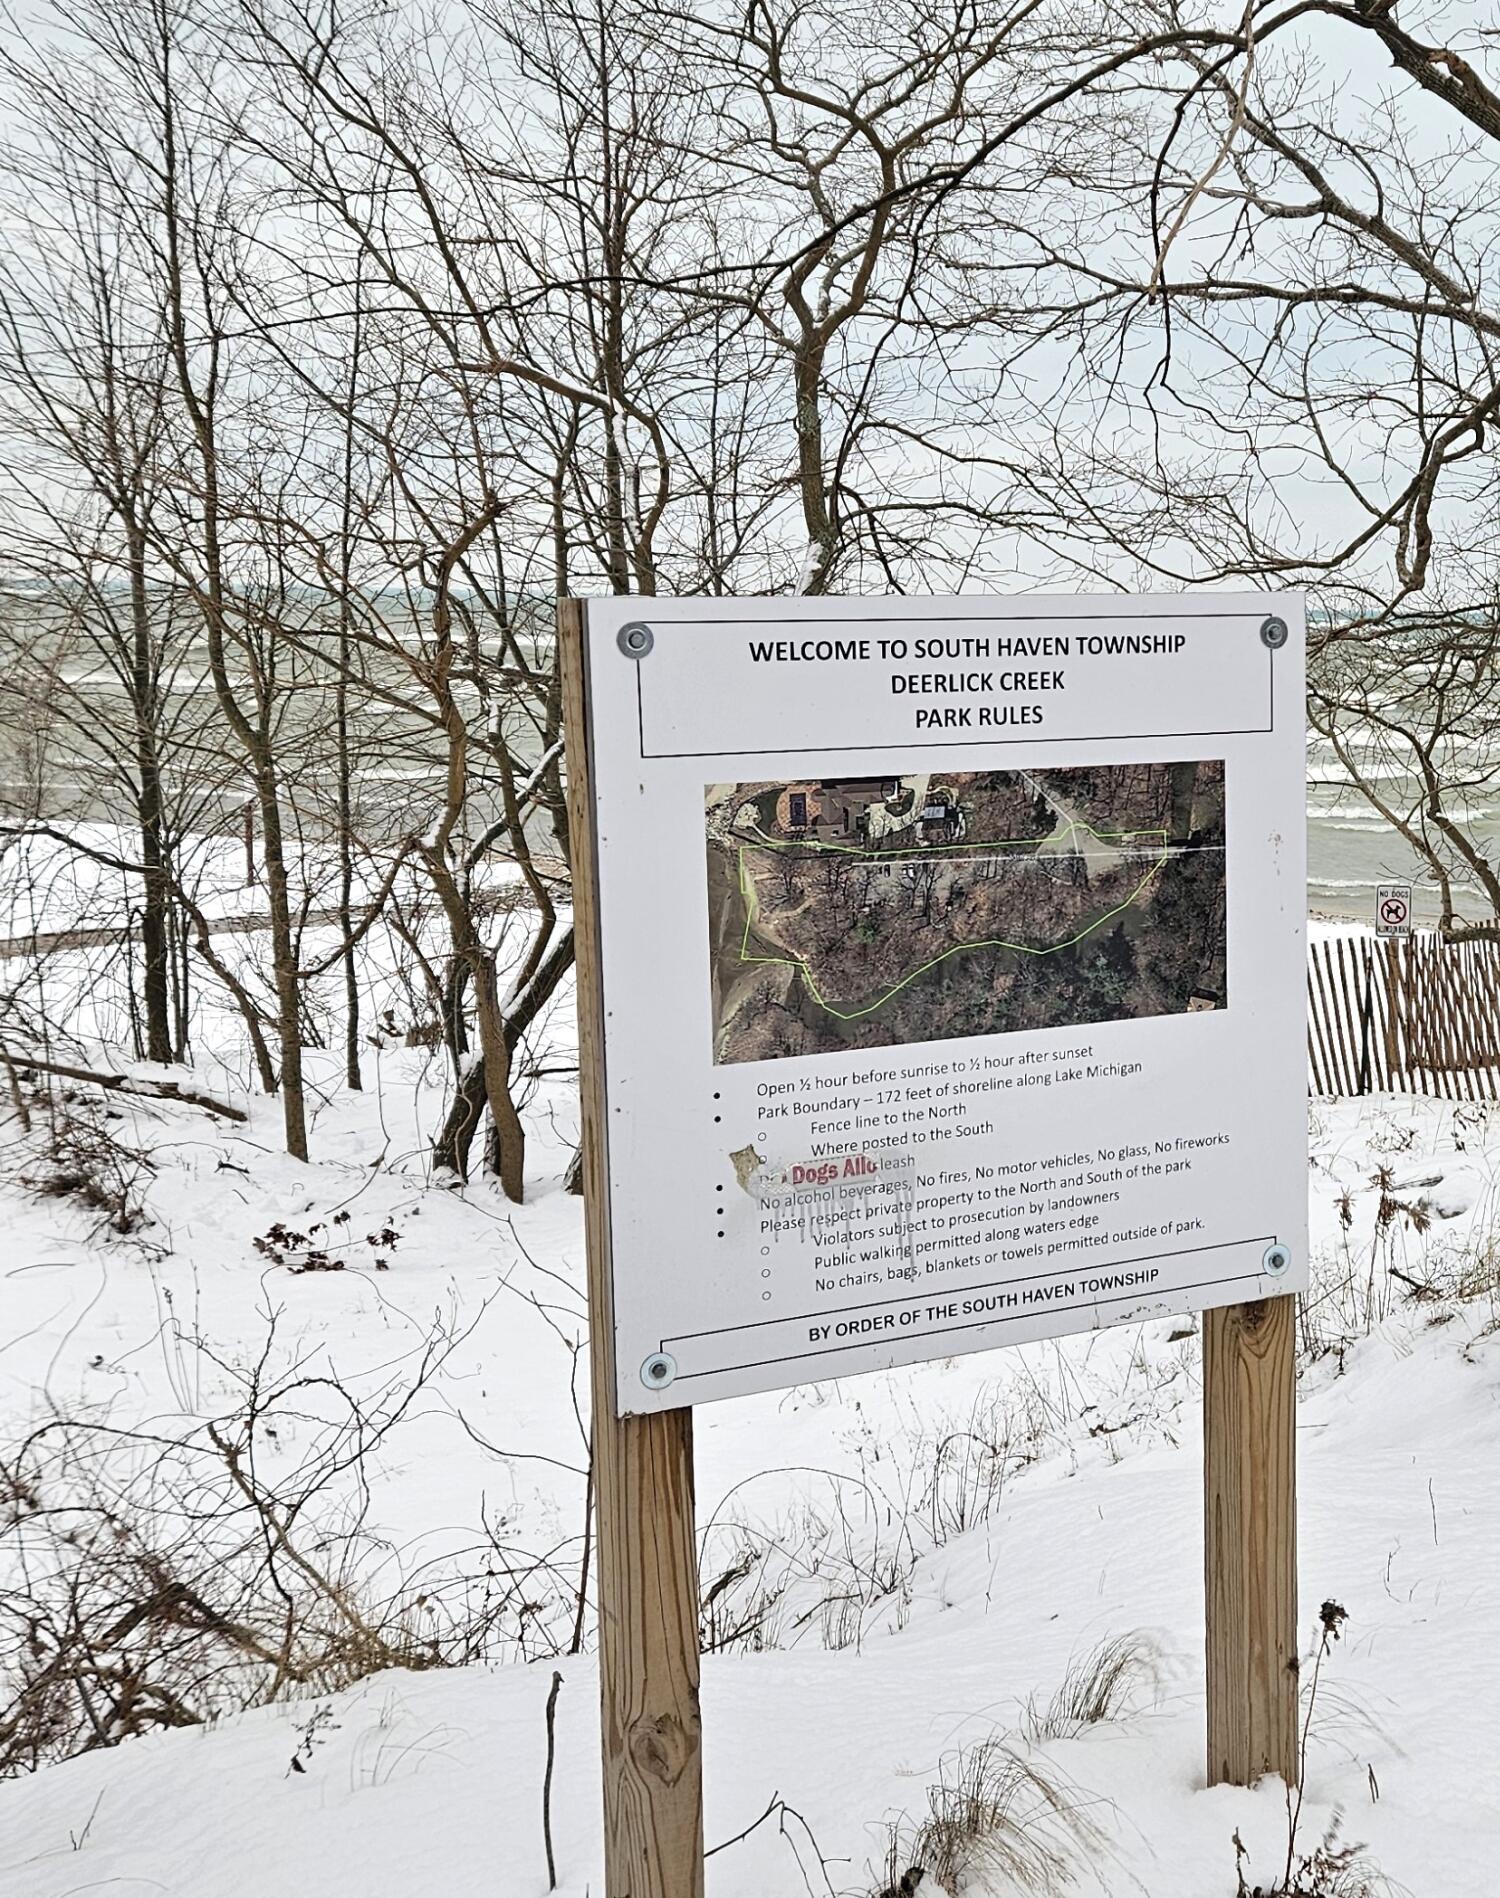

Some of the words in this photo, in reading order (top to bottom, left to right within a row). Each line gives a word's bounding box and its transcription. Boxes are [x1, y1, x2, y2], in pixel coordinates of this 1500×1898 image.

[749, 640, 870, 661] WELCOME
[877, 640, 907, 659] TO
[914, 638, 990, 658] SOUTH
[998, 637, 1069, 656] HAVEN
[1076, 635, 1185, 655] TOWNSHIP
[892, 673, 994, 694] DEERLICK
[1000, 671, 1064, 690] CREEK
[916, 708, 971, 728] PARK
[980, 706, 1043, 725] RULES
[757, 1081, 794, 1097] Open
[800, 1078, 811, 1090] ½
[815, 1074, 847, 1089] hour
[853, 1068, 896, 1085] before
[900, 1063, 948, 1079] sunrise
[952, 1060, 966, 1073] to
[970, 1057, 980, 1070] ½
[984, 1053, 1014, 1069] hour
[1018, 1051, 1048, 1065] after
[1052, 1046, 1093, 1060] sunset
[758, 1104, 788, 1119] Park
[793, 1096, 860, 1116] Boundary
[877, 1090, 901, 1104] 172
[906, 1087, 931, 1100] feet
[936, 1083, 950, 1097] of
[953, 1077, 1012, 1094] shoreline
[1016, 1074, 1051, 1090] along
[1055, 1069, 1082, 1082] Lake
[1087, 1061, 1142, 1078] Michigan
[811, 1121, 850, 1134] Fence
[855, 1116, 879, 1128] line
[884, 1112, 897, 1124] to
[903, 1109, 924, 1122] the
[928, 1103, 966, 1118] North
[811, 1141, 857, 1156] Where
[862, 1134, 908, 1153] posted
[912, 1130, 925, 1143] to
[930, 1128, 951, 1140] the
[956, 1122, 993, 1137] South
[760, 1198, 780, 1210] No
[784, 1189, 834, 1207] alcohol
[839, 1179, 912, 1199] beverages,
[916, 1175, 935, 1187] No
[939, 1171, 971, 1185] fires,
[975, 1167, 994, 1179] No
[998, 1161, 1037, 1175] motor
[1041, 1152, 1094, 1169] vehicles,
[1098, 1148, 1115, 1160] No
[1119, 1145, 1151, 1160] glass,
[1155, 1141, 1172, 1153] No
[1175, 1133, 1230, 1150] fireworks
[793, 1163, 838, 1185] Dogs
[880, 1156, 915, 1171] leash
[760, 1216, 805, 1232] Please
[810, 1209, 861, 1227] respect
[865, 1202, 912, 1221] private
[916, 1194, 973, 1215] property
[978, 1189, 991, 1201] to
[995, 1185, 1016, 1198] the
[1020, 1179, 1056, 1194] North
[1060, 1174, 1083, 1188] and
[1087, 1167, 1123, 1183] South
[1126, 1165, 1138, 1178] of
[1142, 1163, 1162, 1175] the
[1166, 1159, 1191, 1173] park
[814, 1229, 875, 1247] Violators
[879, 1221, 927, 1240] subject
[931, 1217, 945, 1229] to
[949, 1204, 1024, 1228] prosecution
[1030, 1201, 1044, 1216] by
[1048, 1190, 1119, 1211] landowners
[815, 1251, 856, 1269] Public
[860, 1244, 911, 1264] walking
[916, 1235, 981, 1256] permitted
[985, 1227, 1020, 1243] along
[1024, 1221, 1065, 1236] waters
[1069, 1215, 1099, 1231] edge
[816, 1279, 834, 1291] No
[839, 1270, 882, 1288] chairs,
[887, 1264, 922, 1280] bags,
[926, 1255, 980, 1274] blankets
[985, 1254, 997, 1264] or
[1002, 1242, 1044, 1260] towels
[1048, 1232, 1109, 1254] permitted
[1112, 1225, 1157, 1243] outside
[1160, 1223, 1173, 1235] of
[1176, 1218, 1205, 1234] park.
[808, 1326, 831, 1341] BY
[836, 1314, 895, 1336] ORDER
[900, 1310, 921, 1326] OF
[926, 1304, 958, 1322] THE
[963, 1294, 1017, 1314] SOUTH
[1022, 1284, 1075, 1304] HAVEN
[1079, 1269, 1159, 1294] TOWNSHIP
